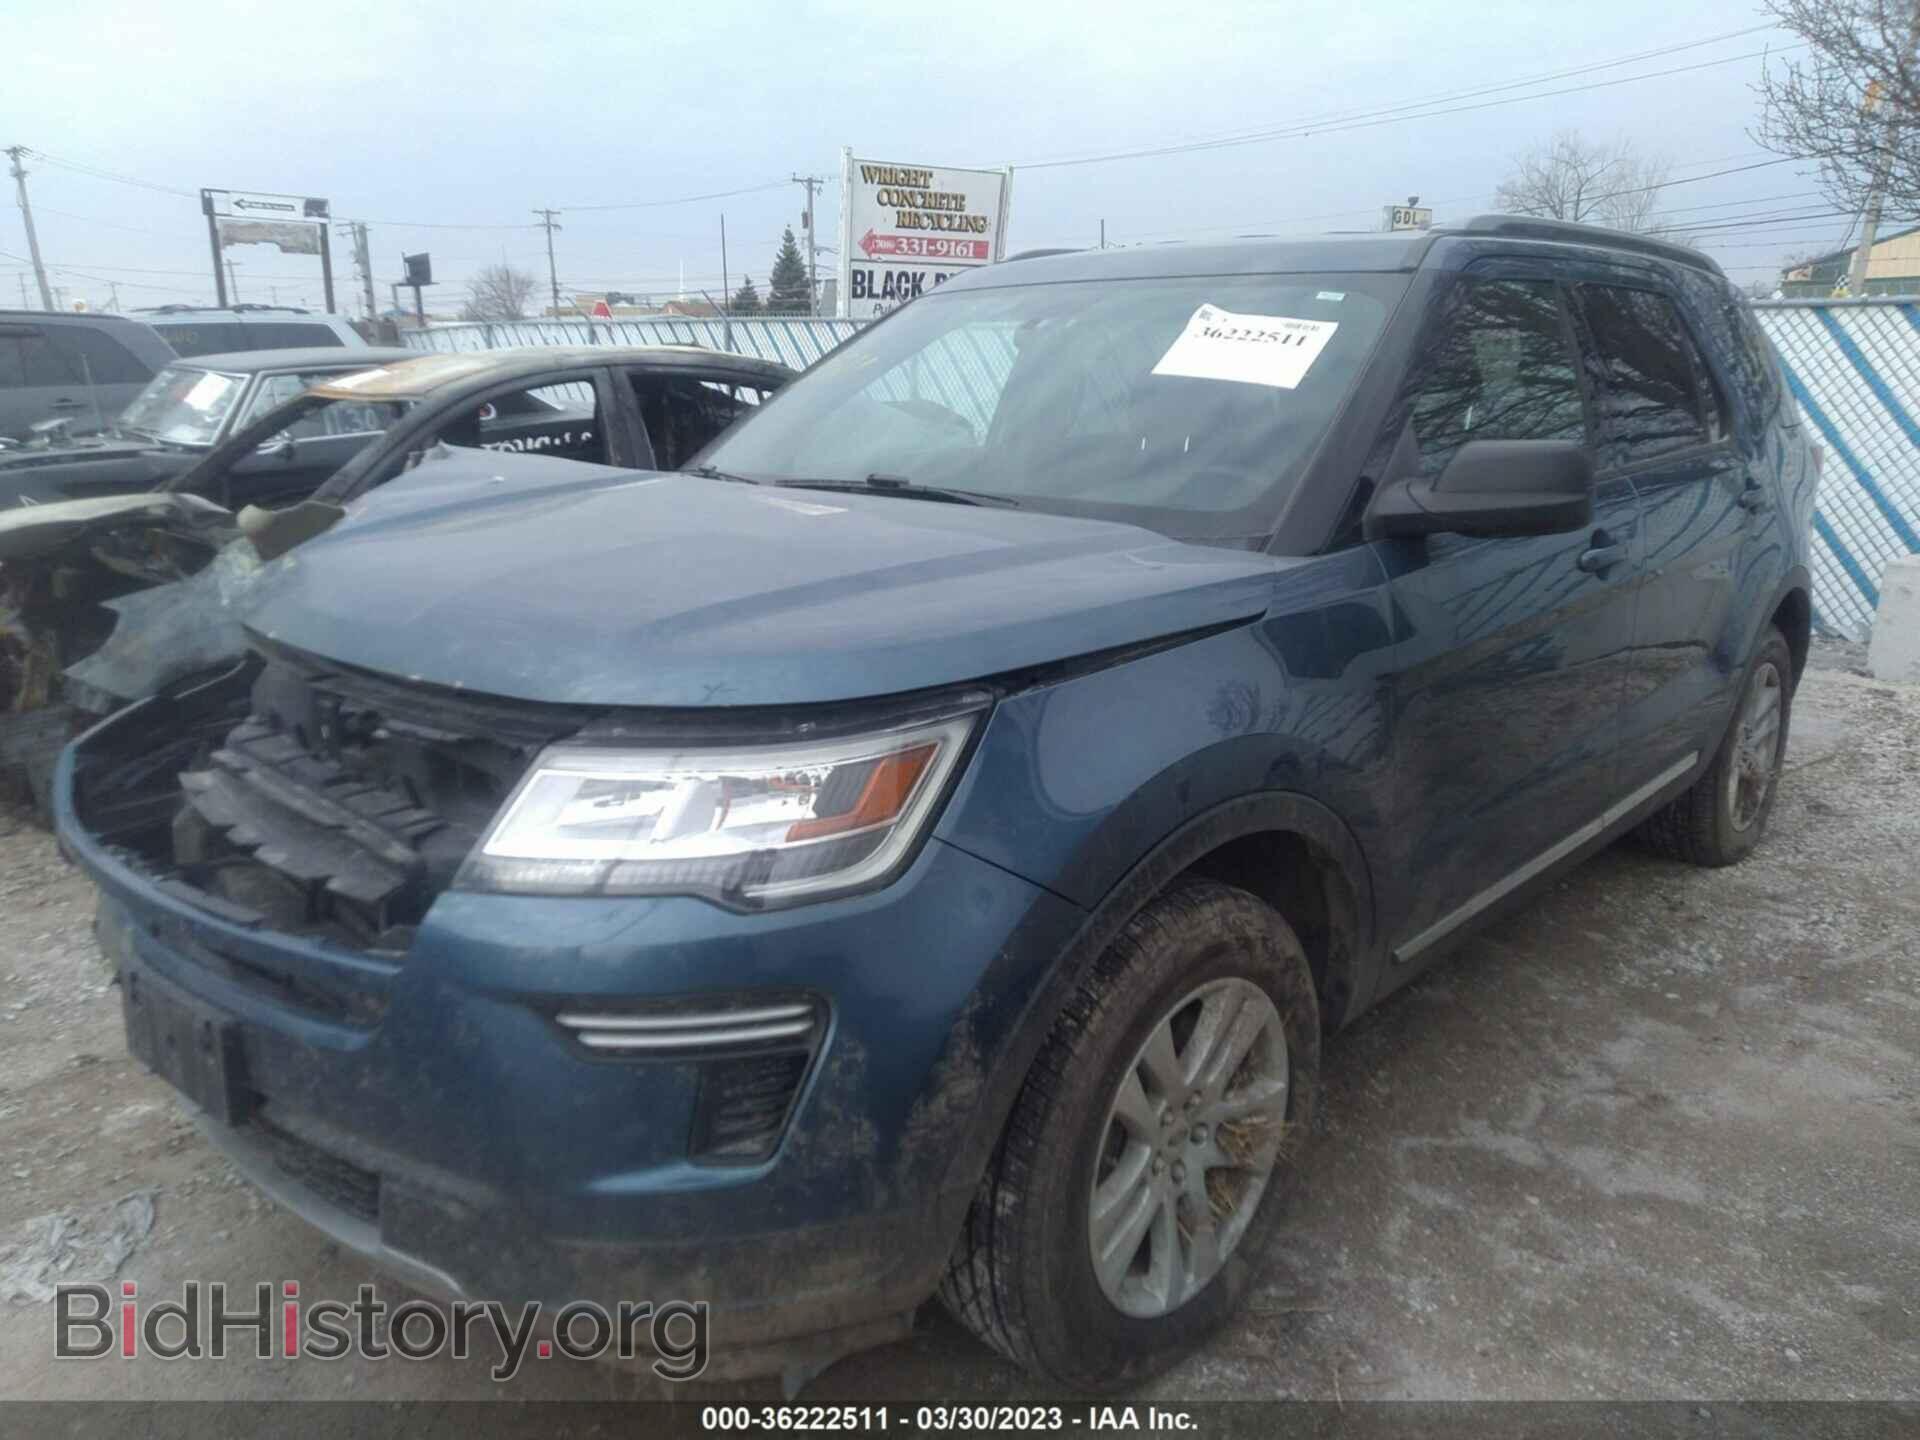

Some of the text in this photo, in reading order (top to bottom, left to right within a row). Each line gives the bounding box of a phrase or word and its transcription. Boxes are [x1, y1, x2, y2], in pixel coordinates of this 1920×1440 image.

[861, 165, 933, 188] WRIGHT
[877, 187, 965, 212] CONCRETE
[895, 211, 987, 233] RECYCLING
[895, 238, 975, 257] 331-9161
[852, 269, 926, 300] BLACK
[1201, 327, 1306, 346] 36222511
